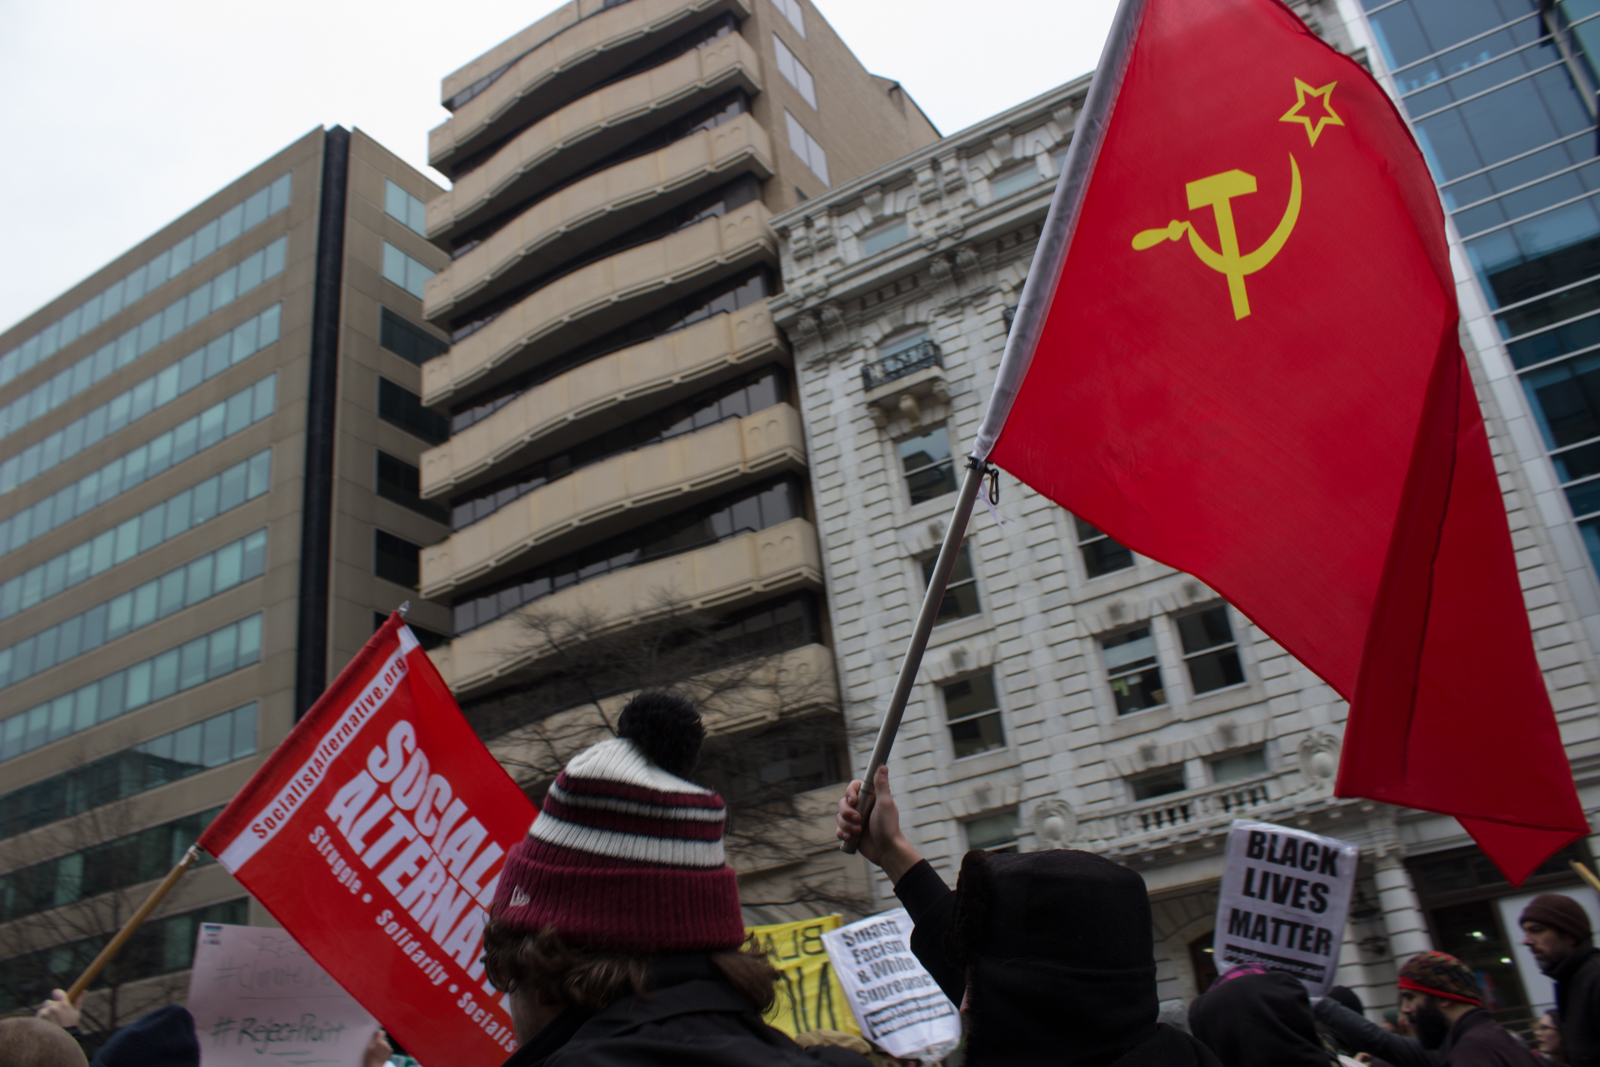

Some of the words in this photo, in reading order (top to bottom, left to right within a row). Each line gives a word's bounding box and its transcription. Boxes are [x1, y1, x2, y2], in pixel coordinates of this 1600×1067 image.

[252, 656, 407, 839] SocialistAlternative.org
[1246, 830, 1340, 878] BLACK
[309, 825, 363, 895] Struggle
[376, 909, 450, 986] Solidarity
[1243, 866, 1330, 914] LIVES
[842, 919, 902, 947] Smash
[852, 939, 907, 965] Facism
[1228, 907, 1333, 957] MATTER
[856, 973, 937, 1006] Supremac
[858, 969, 871, 984] &
[870, 956, 916, 979] White
